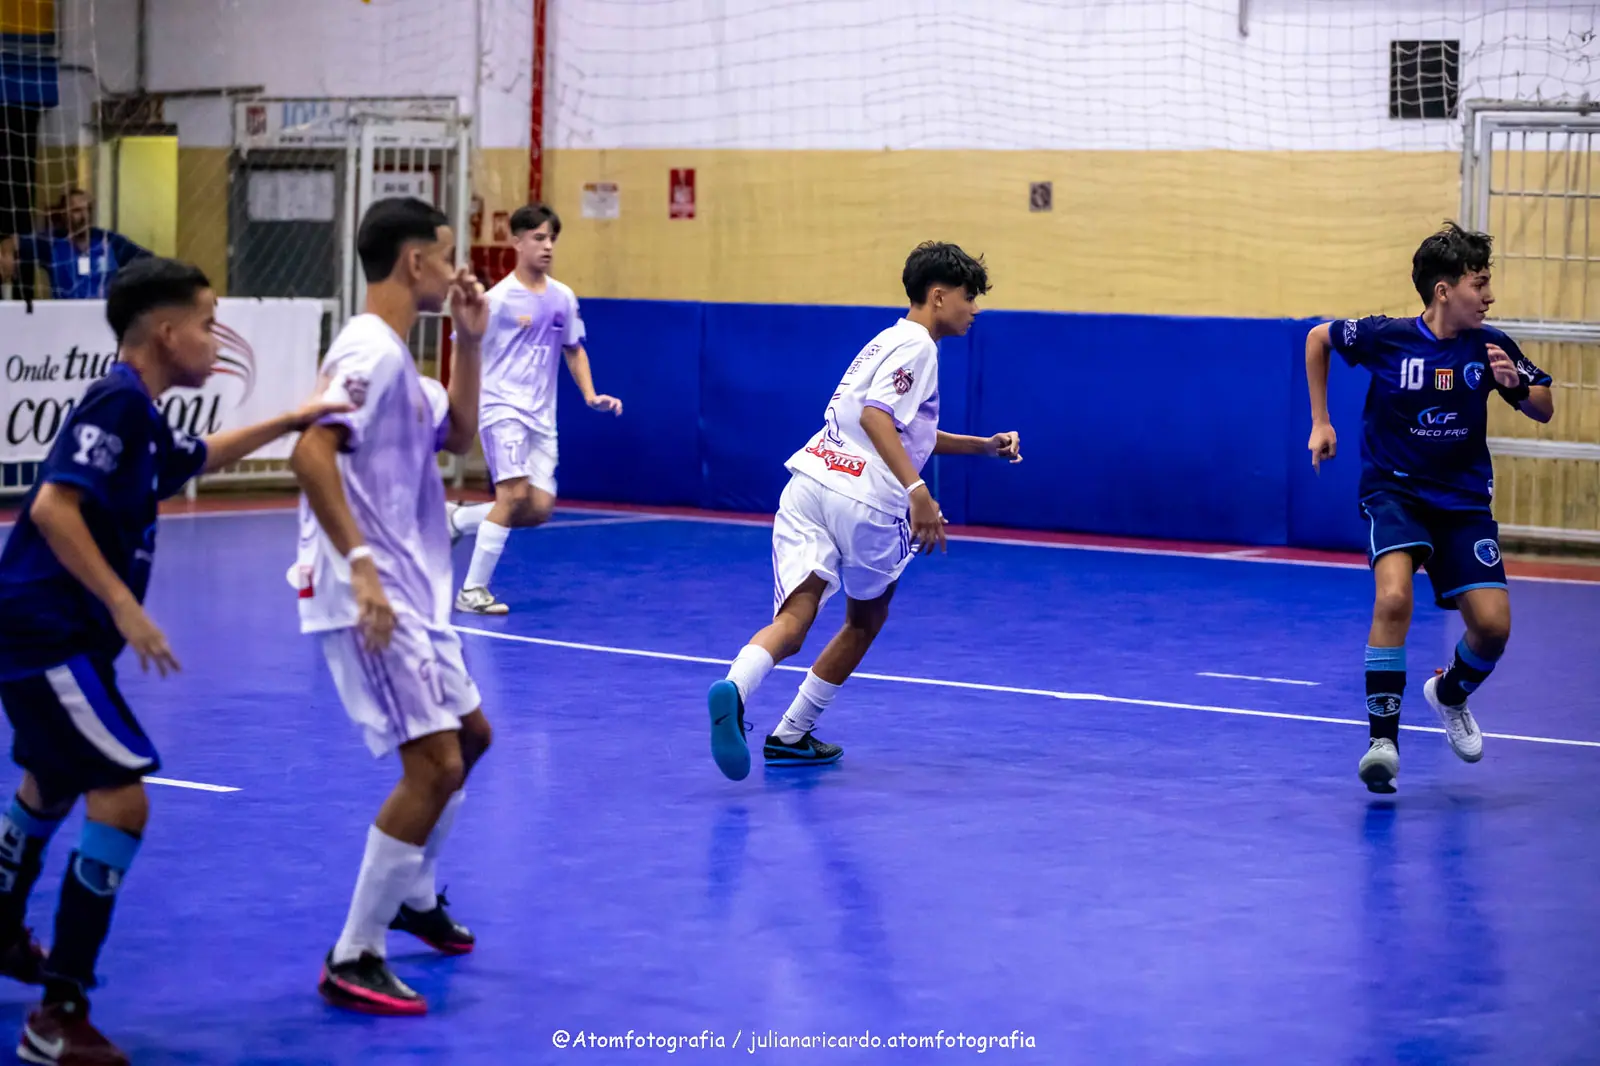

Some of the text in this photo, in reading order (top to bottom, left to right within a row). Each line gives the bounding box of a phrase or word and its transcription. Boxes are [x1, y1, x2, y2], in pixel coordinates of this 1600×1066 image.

[6, 345, 119, 382] Onde tud
[1400, 357, 1424, 390] 10
